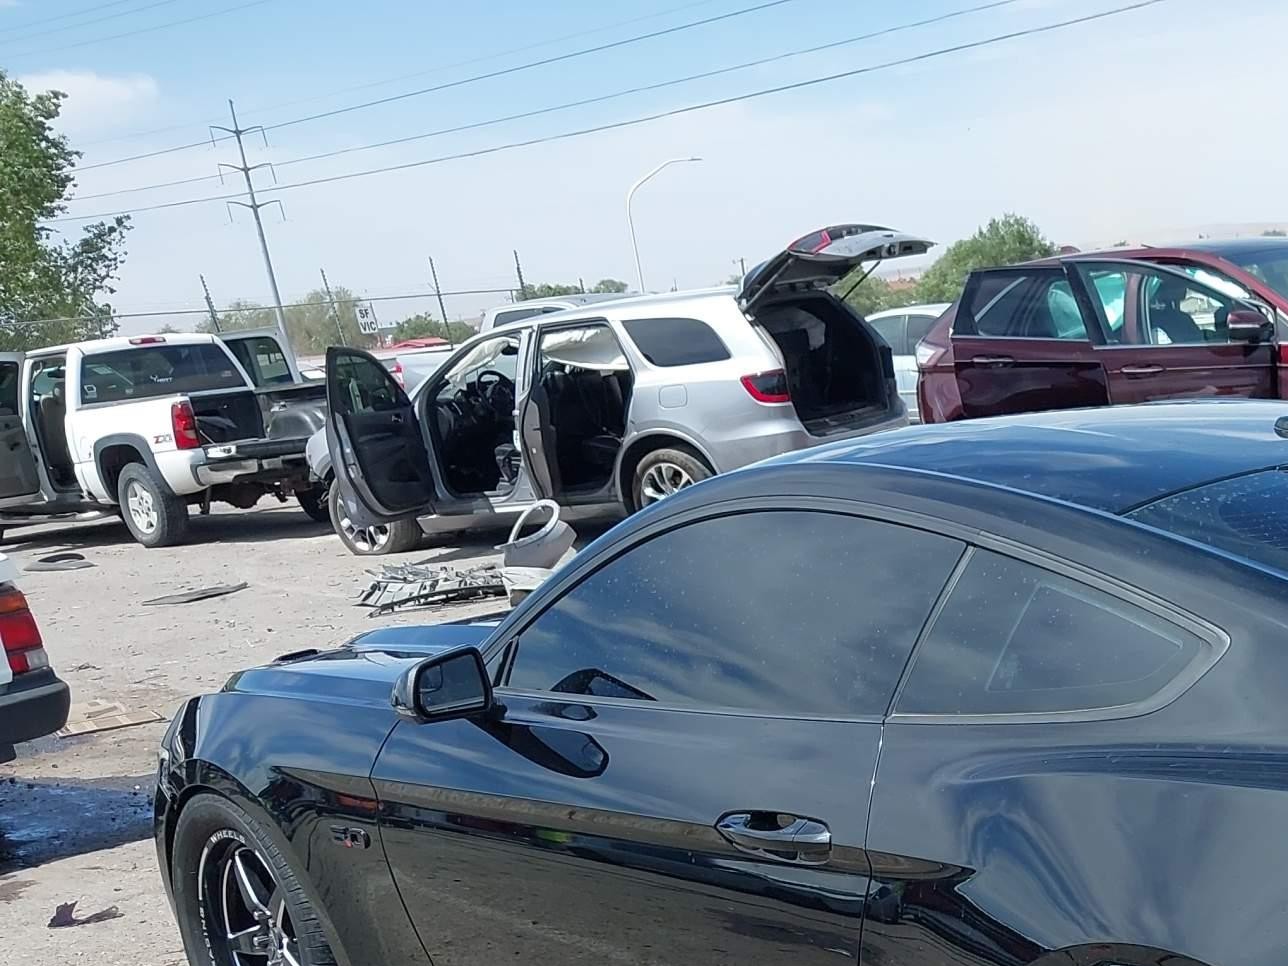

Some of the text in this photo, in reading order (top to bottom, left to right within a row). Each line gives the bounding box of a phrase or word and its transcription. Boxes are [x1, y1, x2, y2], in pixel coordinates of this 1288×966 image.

[359, 309, 370, 319] SF
[360, 321, 377, 332] VIC
[210, 828, 246, 844] WHEELS
